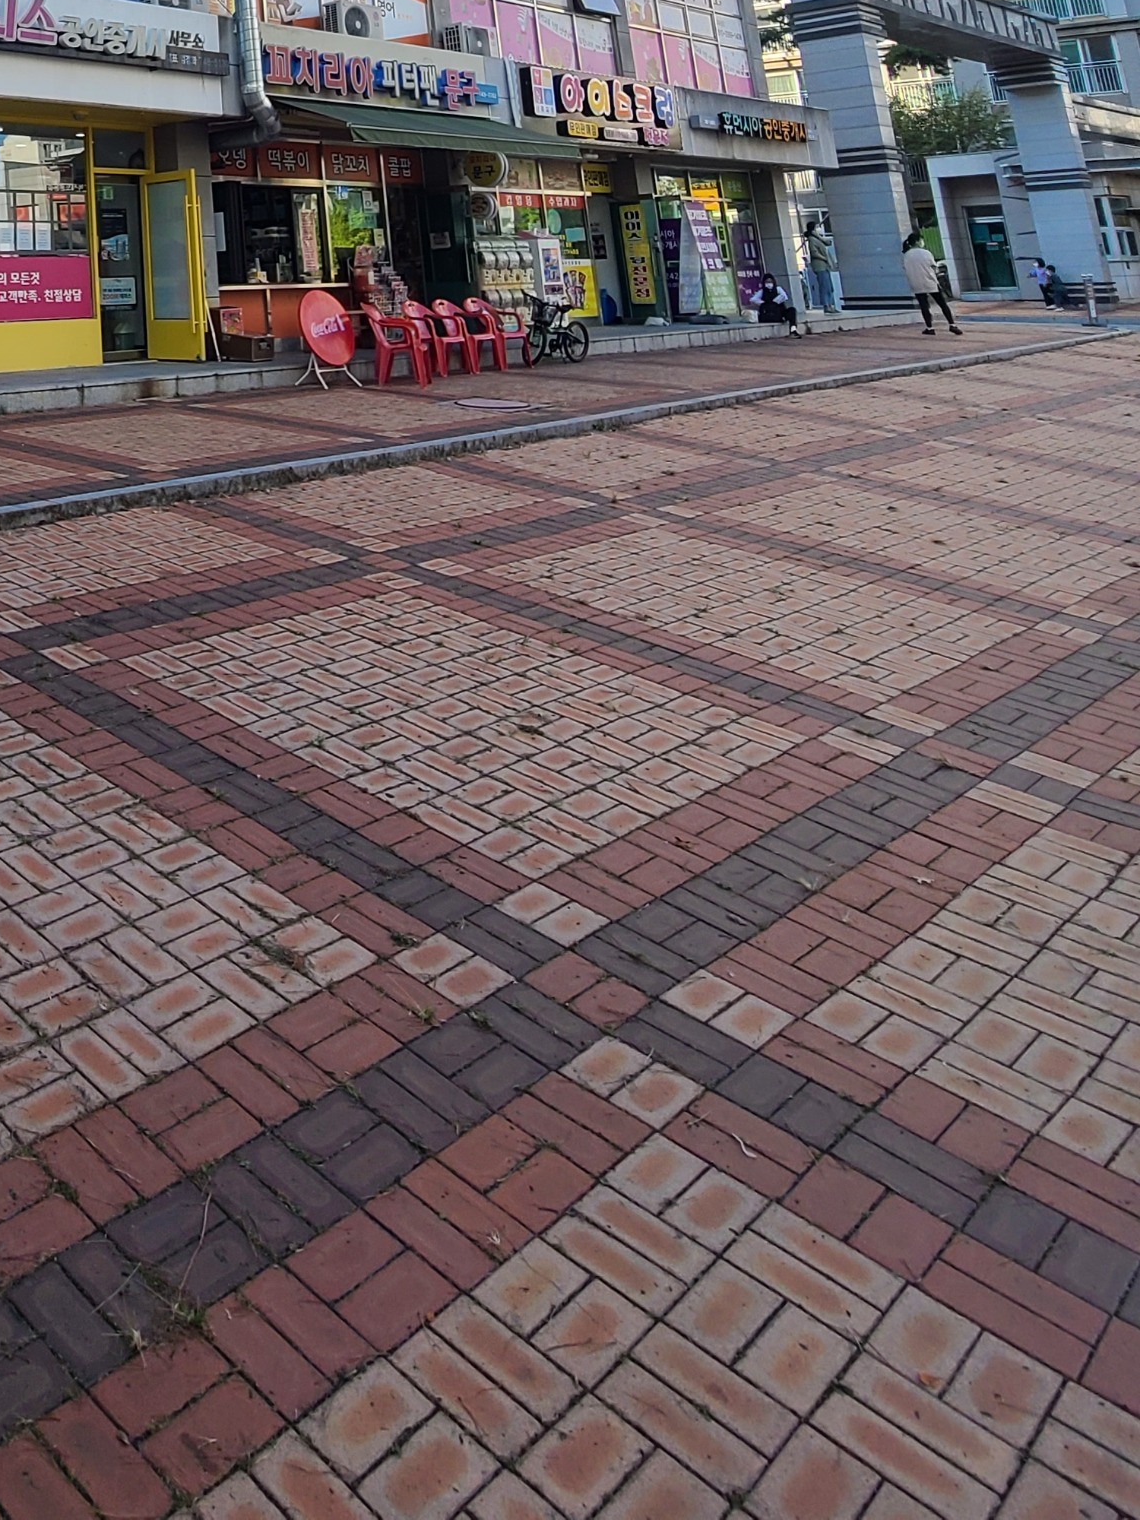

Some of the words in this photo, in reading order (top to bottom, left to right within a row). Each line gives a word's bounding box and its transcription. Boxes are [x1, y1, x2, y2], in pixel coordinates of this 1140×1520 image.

[59, 15, 167, 60] 공인중개사
[168, 29, 205, 48] 사무소
[381, 59, 441, 106] 피터팬
[443, 68, 480, 111] 문구
[722, 111, 763, 138] 휴먼시아
[267, 148, 310, 173] 떡볶이
[331, 152, 371, 176] 닭꼬치
[387, 156, 412, 177] 콜팝
[9, 271, 40, 285] 모든것
[43, 288, 83, 303] 친절상담
